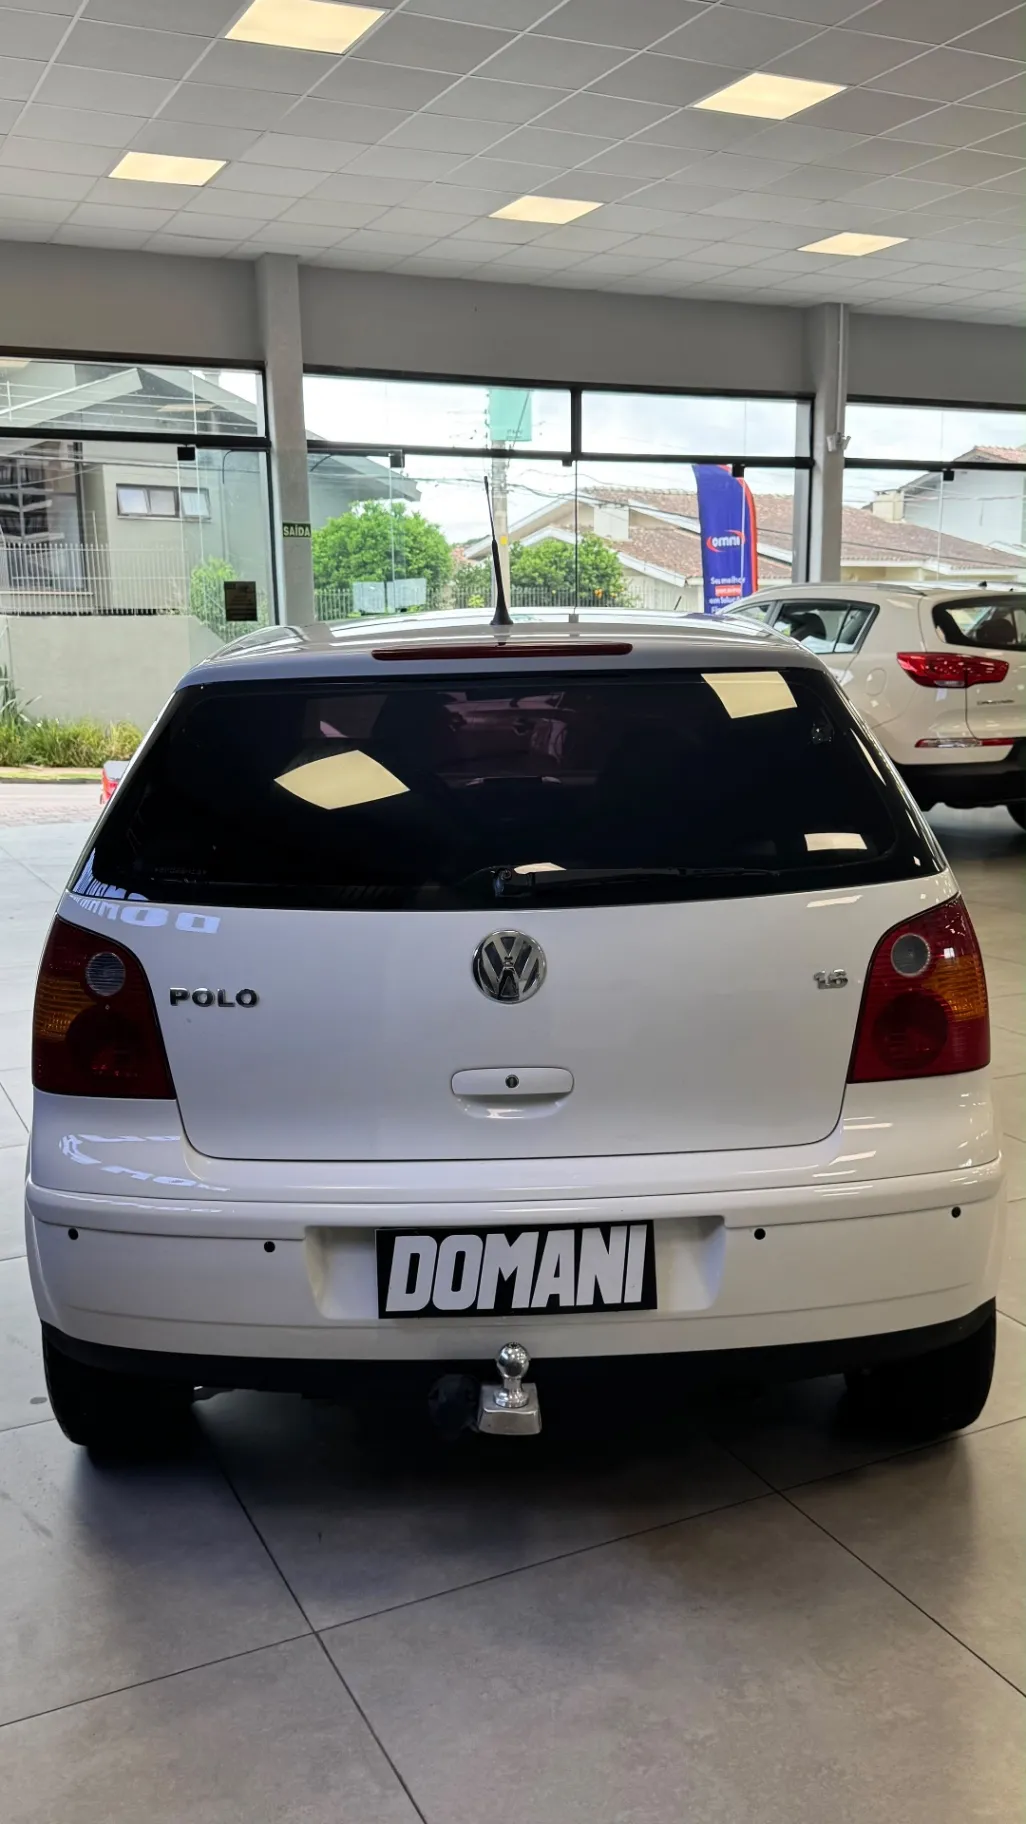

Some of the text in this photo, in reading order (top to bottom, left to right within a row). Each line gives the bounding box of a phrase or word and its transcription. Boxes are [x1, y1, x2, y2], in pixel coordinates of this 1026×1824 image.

[283, 524, 311, 537] SAÍDA
[712, 535, 741, 548] omni
[169, 987, 260, 1008] POLO
[385, 1224, 648, 1312] DOMANI
